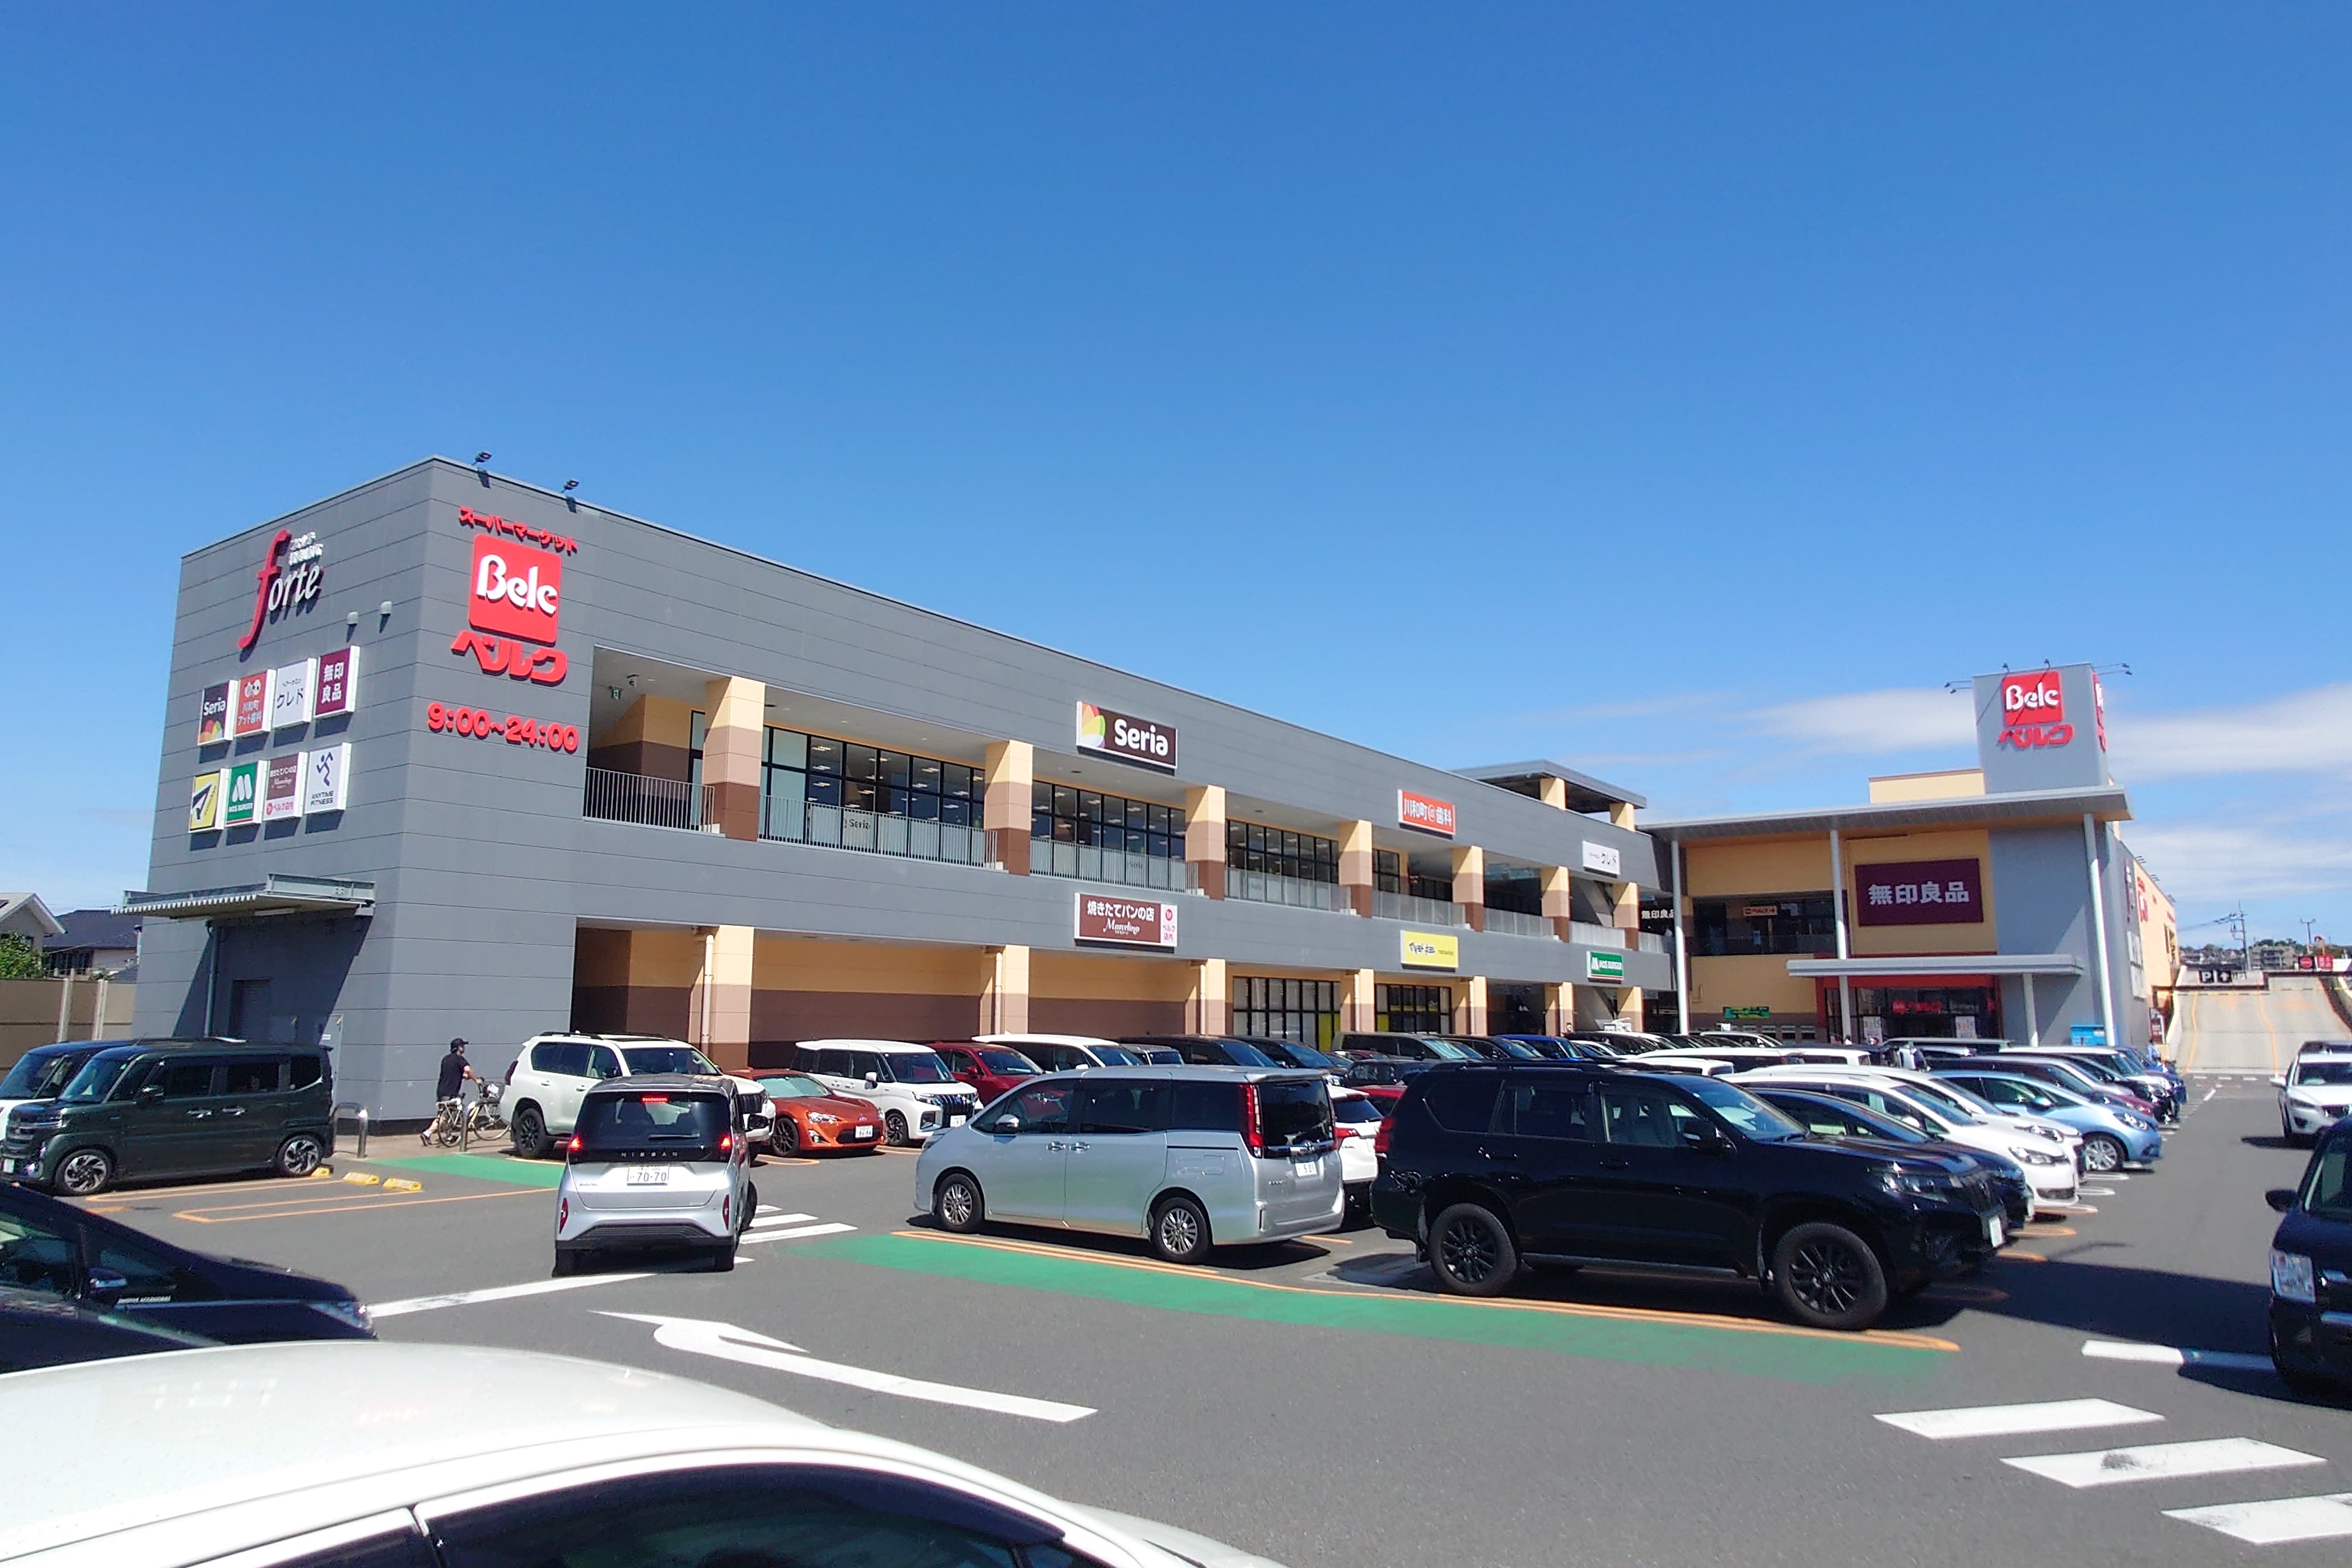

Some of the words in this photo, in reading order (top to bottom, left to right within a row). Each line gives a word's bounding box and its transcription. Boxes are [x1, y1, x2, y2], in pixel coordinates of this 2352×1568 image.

[459, 506, 578, 553] スーパーマーケット
[237, 529, 322, 649] forte
[477, 554, 557, 614] Belc
[451, 630, 568, 683] ベルク
[323, 662, 344, 682] 無印
[321, 682, 342, 704] 良品
[2006, 682, 2059, 710] Belc
[203, 697, 226, 716] Seria
[1114, 718, 1168, 757] Seria
[1997, 723, 2075, 748] ベルク
[1868, 881, 1969, 905] 無印良品
[1087, 900, 1155, 922] 焼きたてパンの店
[2202, 971, 2211, 982] P
